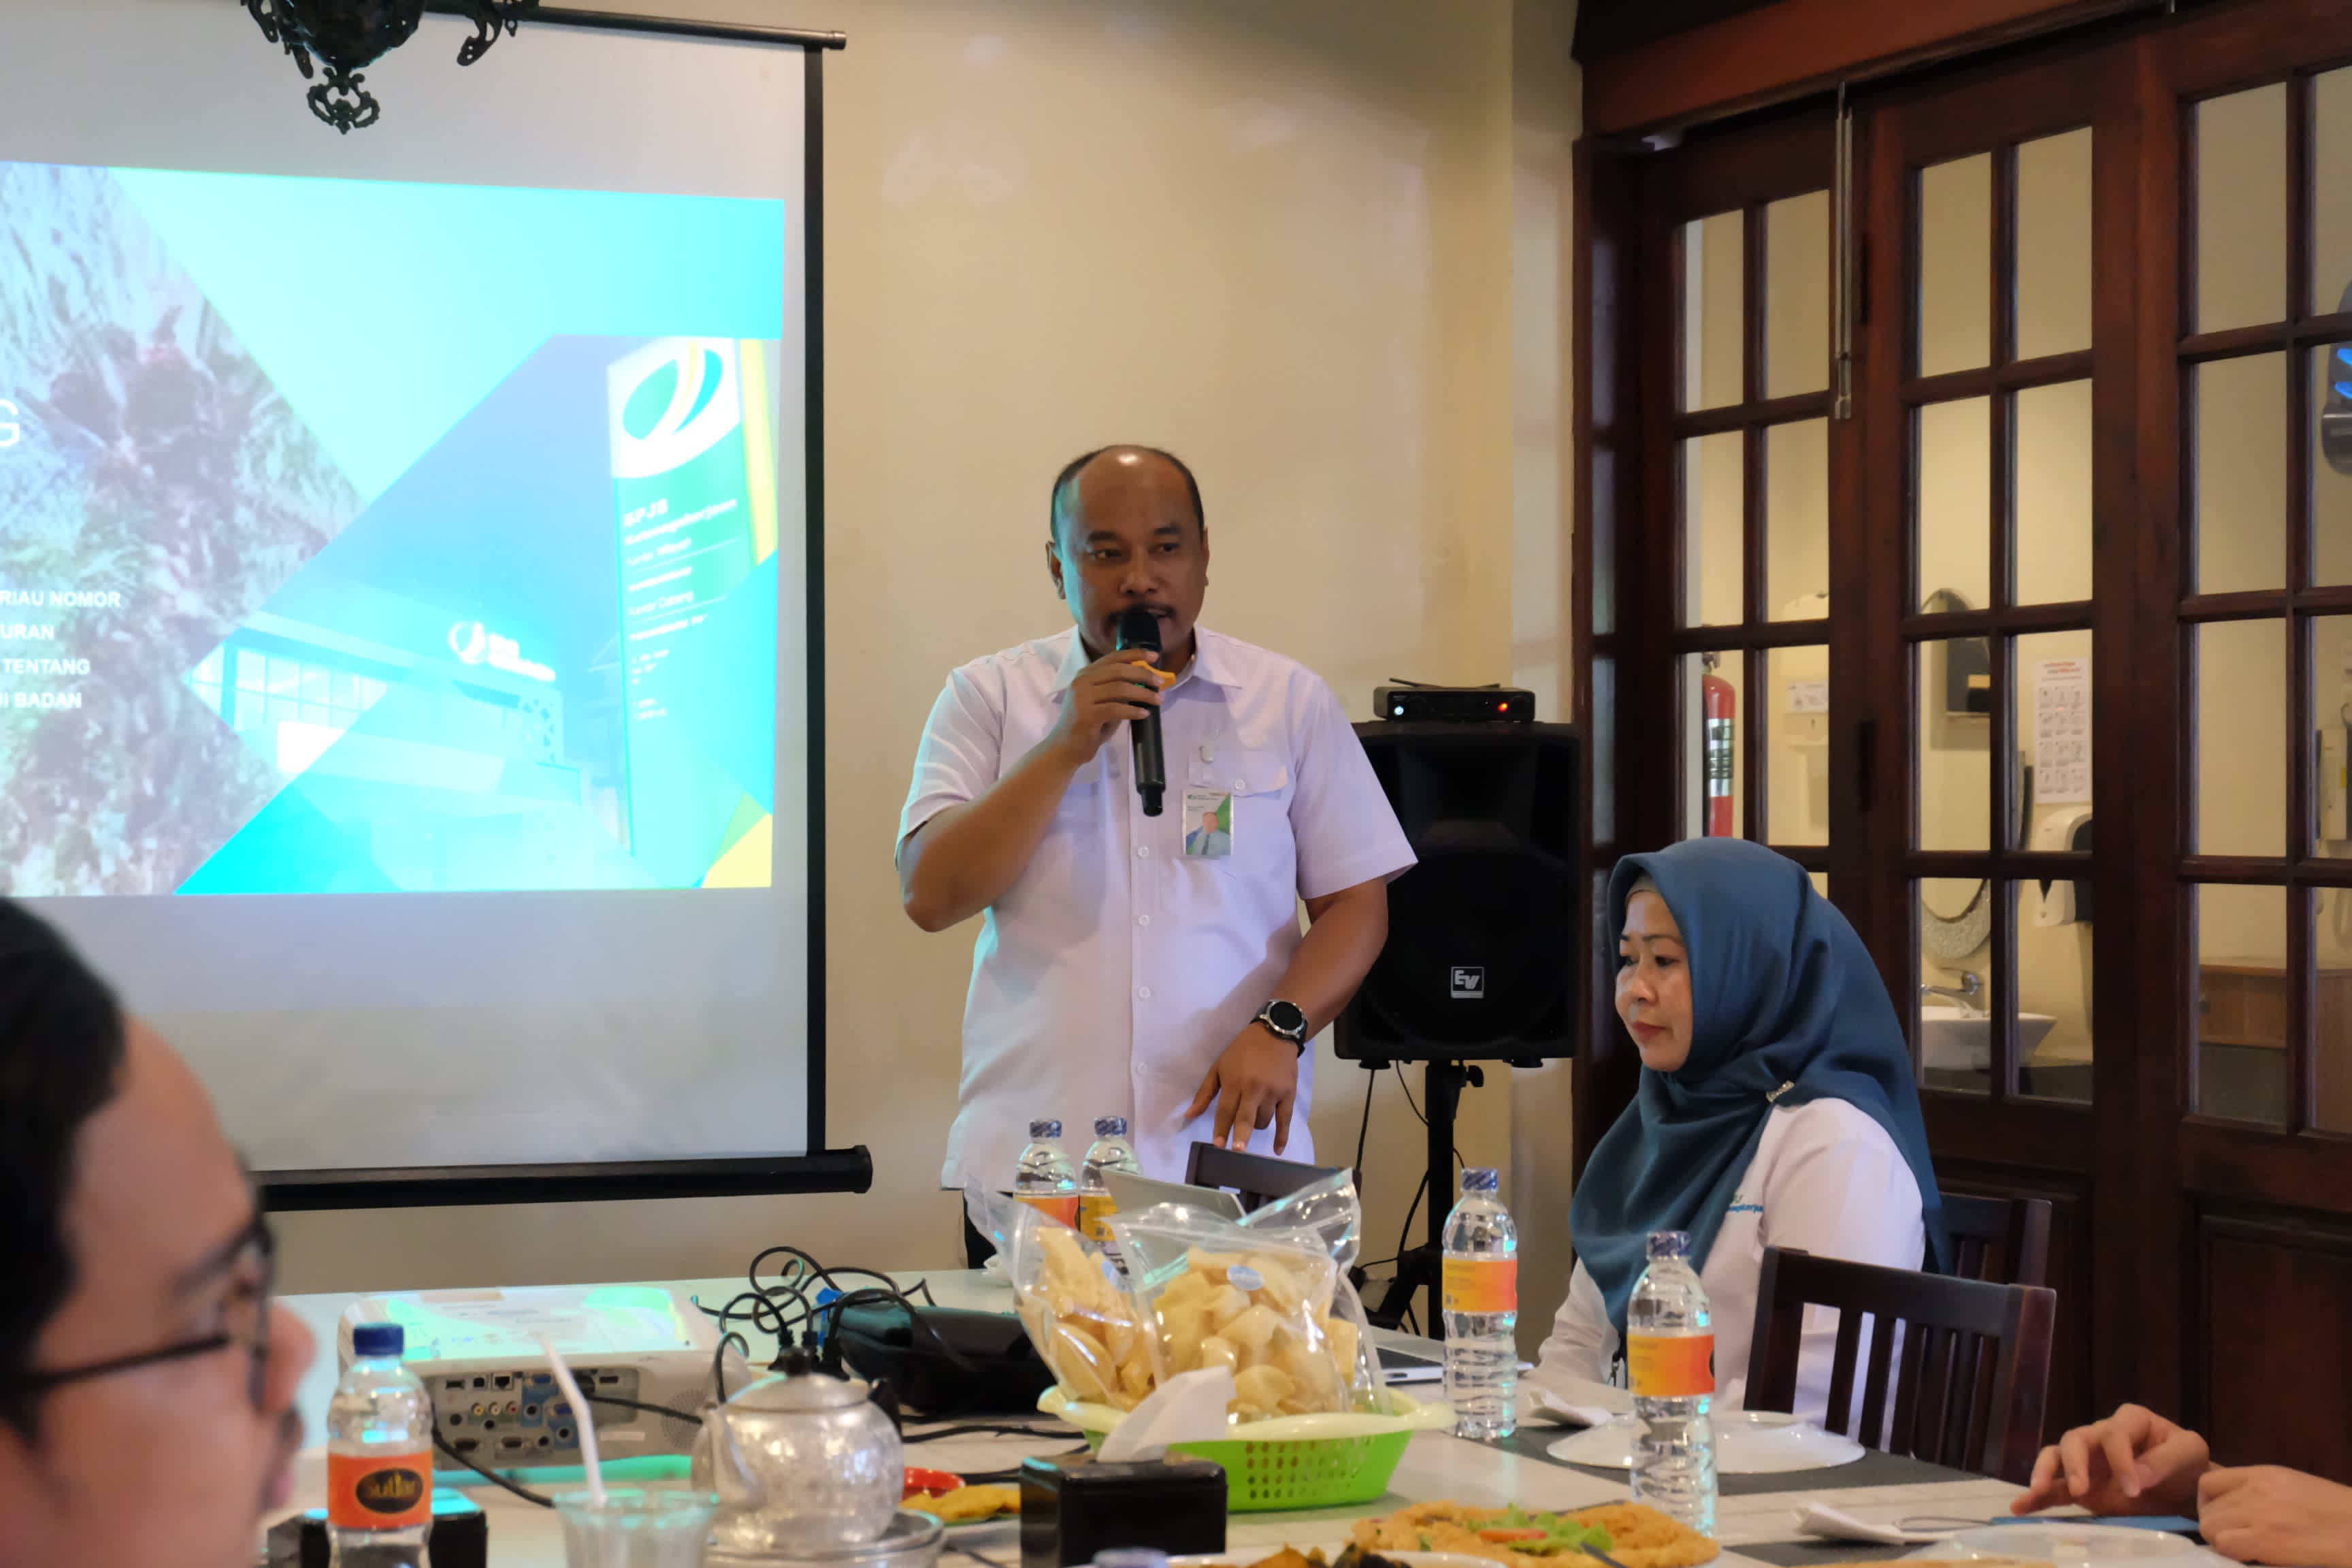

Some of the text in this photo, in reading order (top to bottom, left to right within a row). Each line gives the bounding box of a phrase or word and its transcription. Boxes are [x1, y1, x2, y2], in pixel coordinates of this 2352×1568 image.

[0, 590, 121, 607] RIAU NOMOR
[3, 658, 91, 675] TENTANG
[14, 691, 82, 708] BADAN
